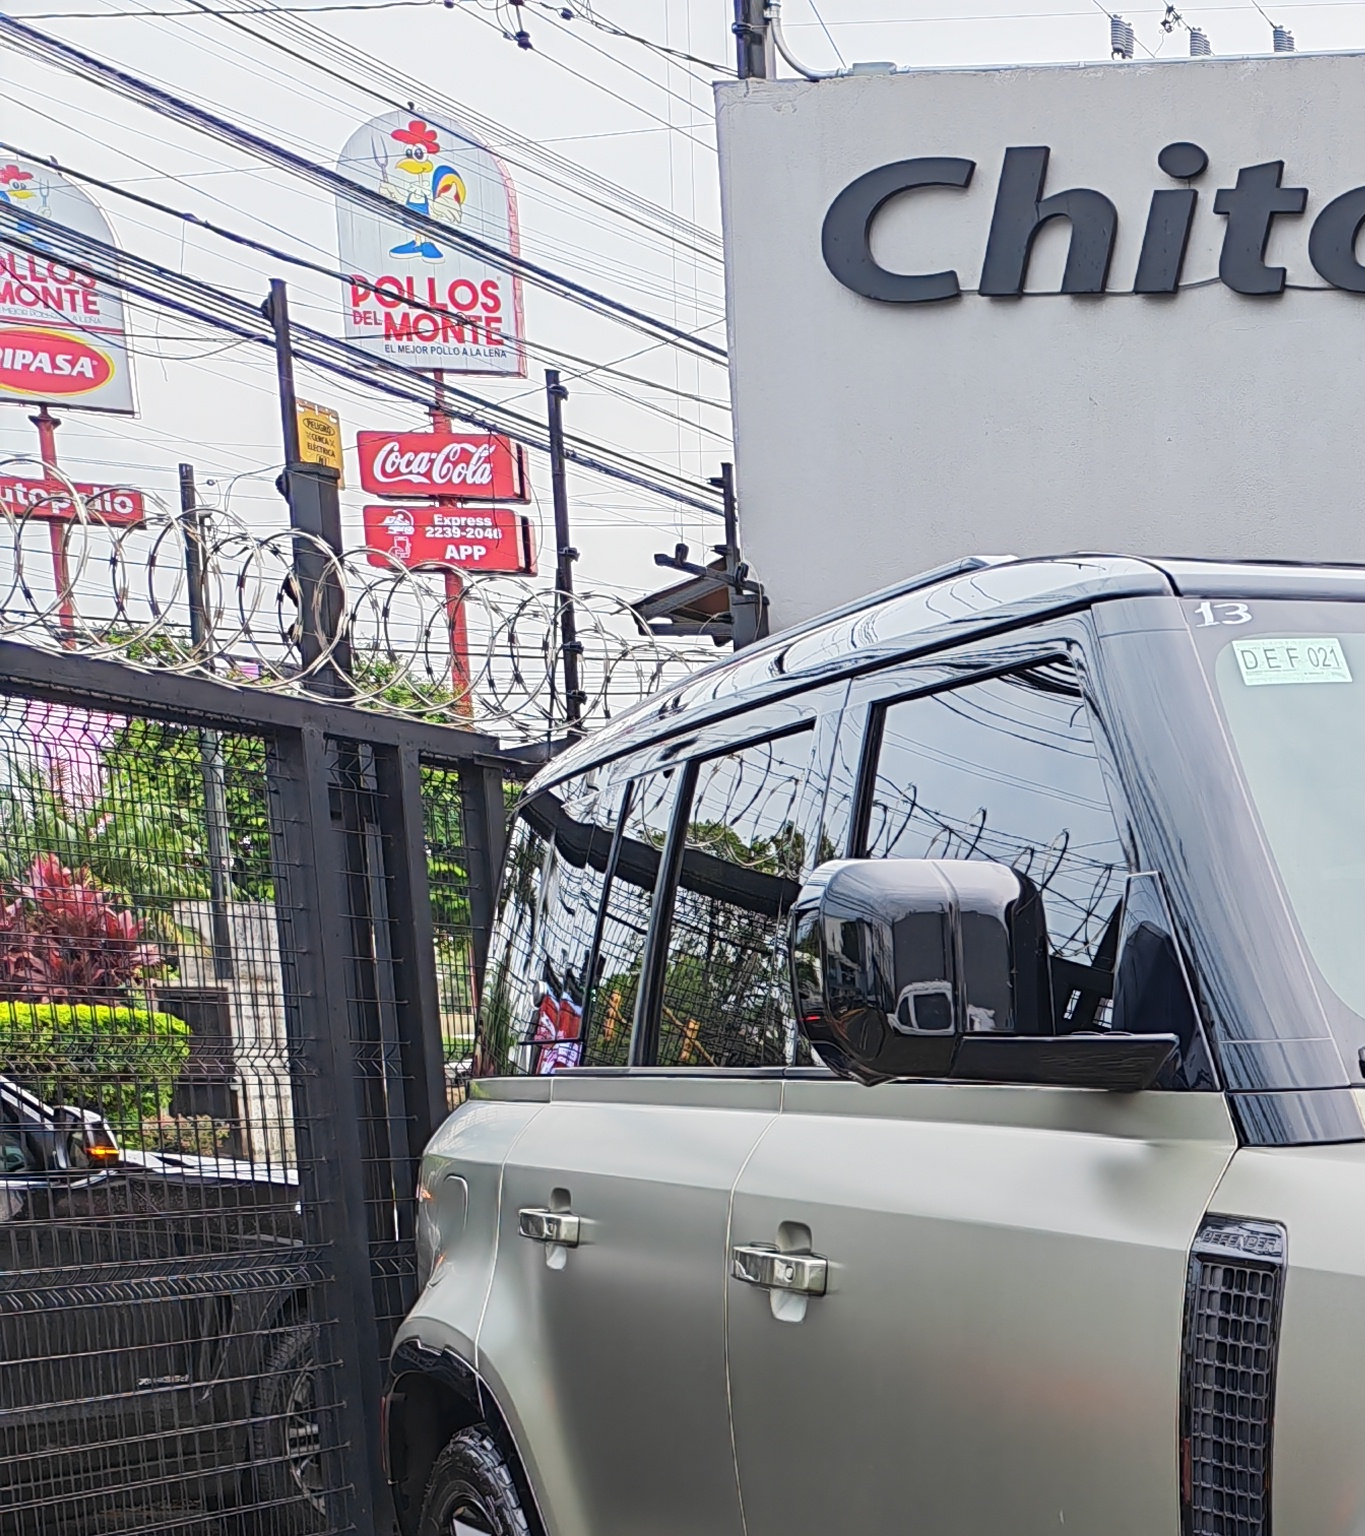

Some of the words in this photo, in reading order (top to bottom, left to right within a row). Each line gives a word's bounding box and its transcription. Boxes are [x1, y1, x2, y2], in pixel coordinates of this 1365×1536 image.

[351, 274, 501, 313] POLLOS
[352, 310, 382, 326] DEL
[384, 312, 504, 346] MONTE
[385, 344, 396, 353] EL
[397, 345, 428, 354] MEJOR
[431, 346, 459, 355] POLLO
[462, 347, 468, 355] A
[470, 348, 481, 357] LA
[483, 348, 507, 358] LEÑA
[373, 442, 497, 485] Coca-Cola
[434, 514, 492, 527] Express
[444, 545, 487, 561] APP
[1194, 601, 1253, 628] 13
[1202, 1229, 1277, 1252] DEFENDER
